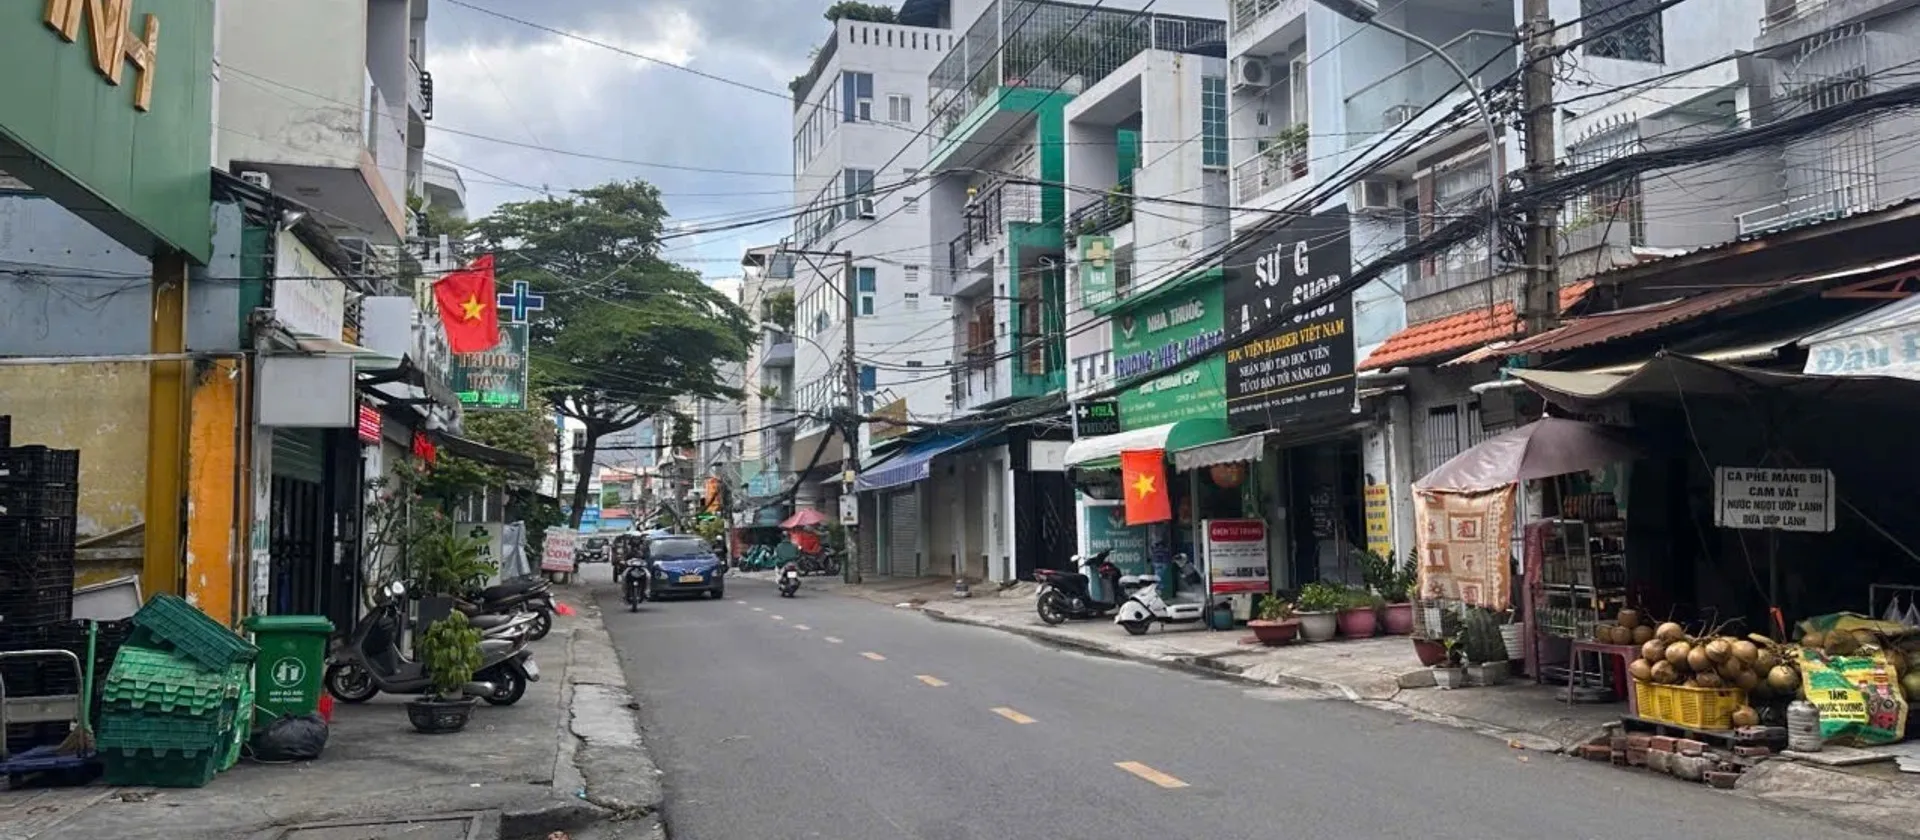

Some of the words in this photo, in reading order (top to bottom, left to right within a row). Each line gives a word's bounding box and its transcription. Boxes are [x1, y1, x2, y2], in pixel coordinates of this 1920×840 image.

[1265, 332, 1298, 353] BARBER
[1322, 318, 1345, 338] NAM
[1314, 363, 1332, 377] CAO
[1771, 472, 1807, 484] MANG
[1748, 486, 1775, 497] CAM
